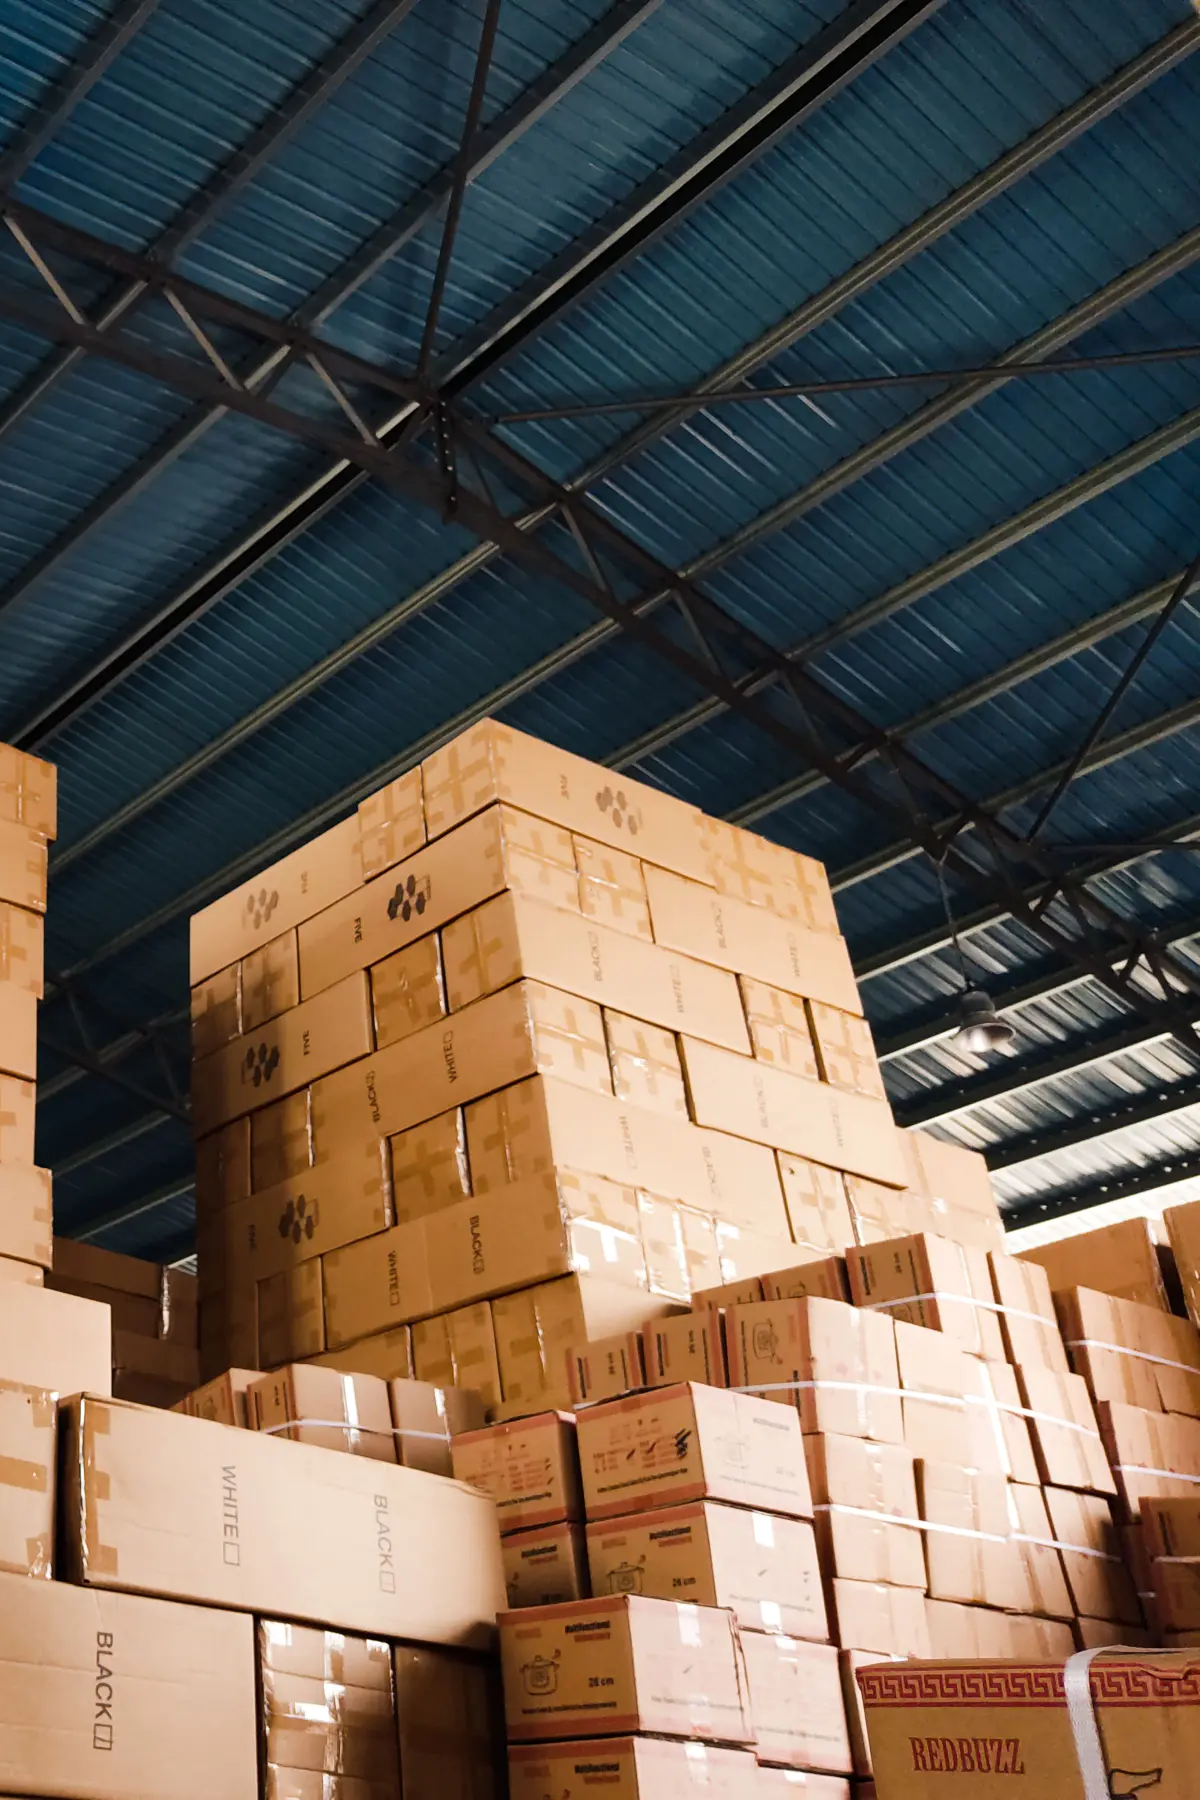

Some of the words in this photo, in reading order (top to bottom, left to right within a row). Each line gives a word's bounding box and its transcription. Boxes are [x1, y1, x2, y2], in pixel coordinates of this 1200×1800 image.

[354, 917, 363, 944] FIVE
[443, 1045, 458, 1084] WHITE
[367, 1084, 381, 1123] BLACK
[470, 1215, 482, 1260] BLACK
[388, 1250, 399, 1293] WHITE
[222, 1465, 239, 1539] WHITE
[374, 1494, 394, 1568] BLACK
[95, 1631, 113, 1720] BLACK
[908, 1736, 1025, 1774] REDBUZZ
